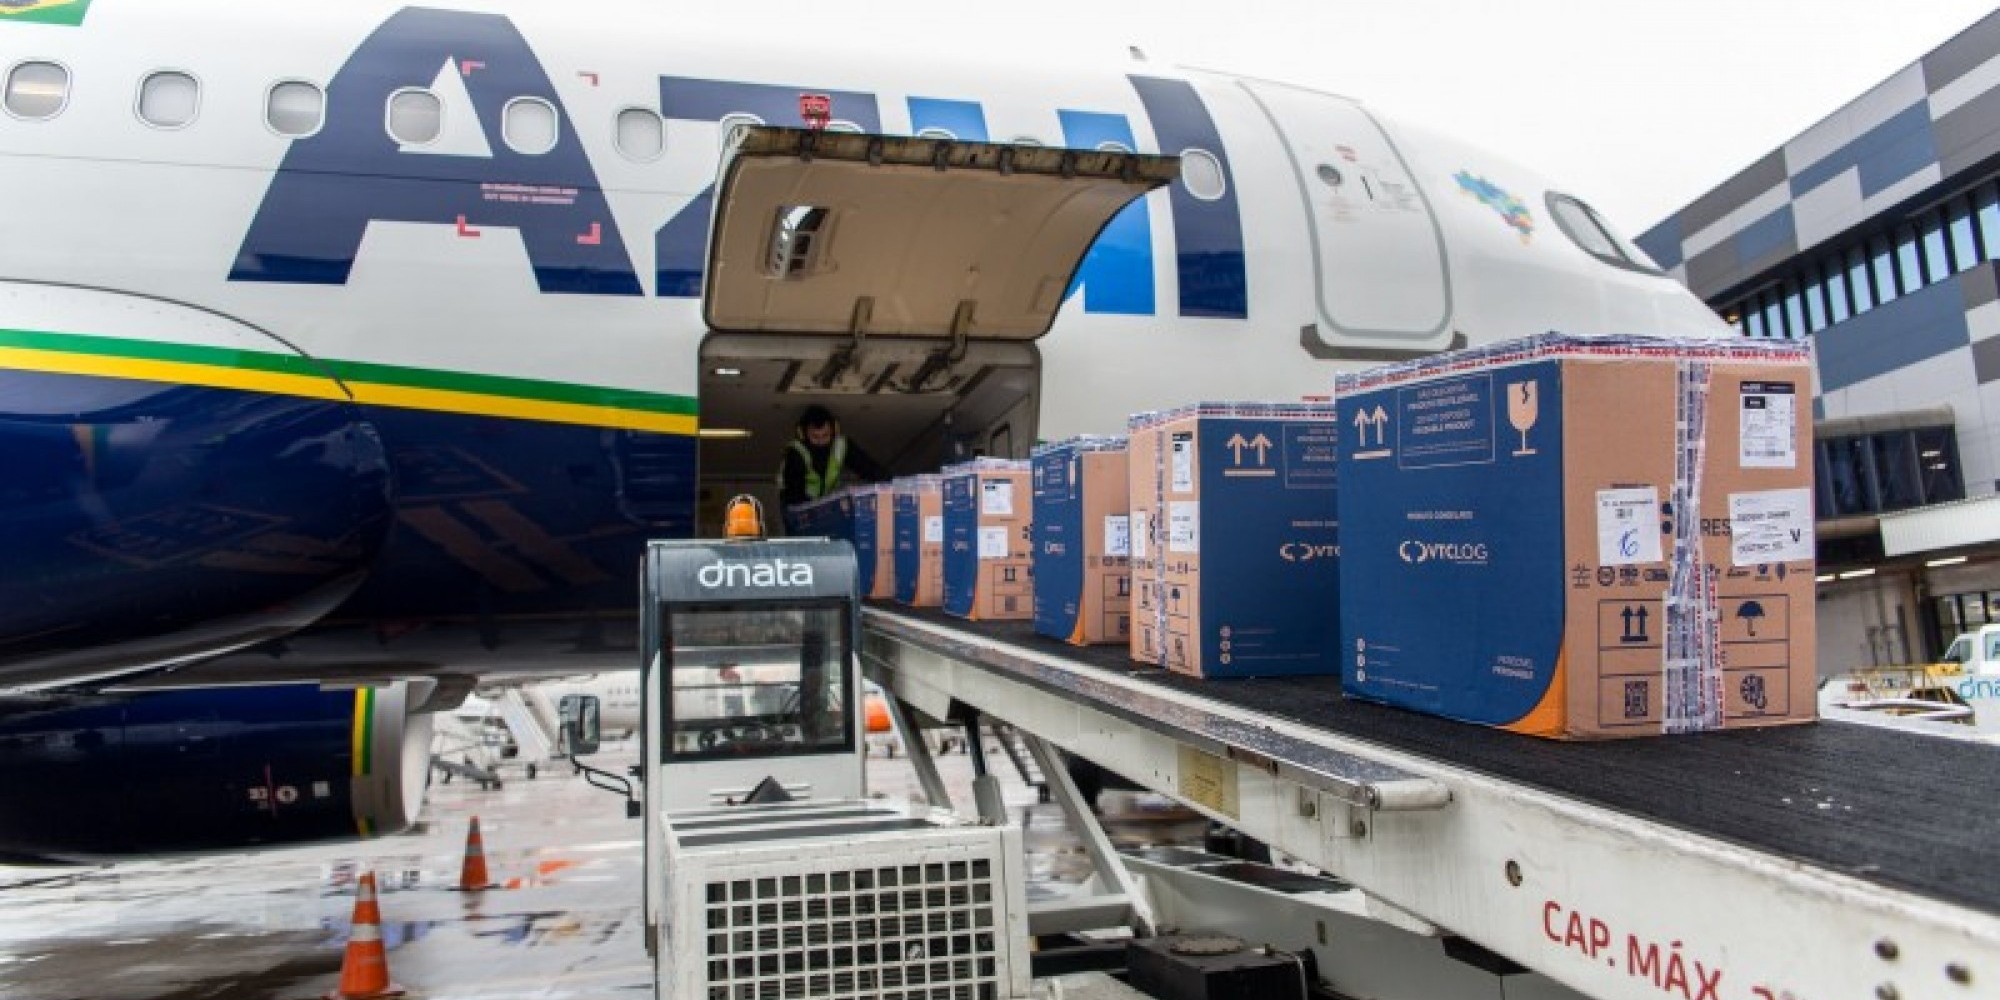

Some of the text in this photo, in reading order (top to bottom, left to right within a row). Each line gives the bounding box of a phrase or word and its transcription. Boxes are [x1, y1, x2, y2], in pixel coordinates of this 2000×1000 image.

[1422, 543, 1489, 560] VTCLOG
[699, 558, 814, 588] dnata
[1543, 900, 1616, 967] CAP.
